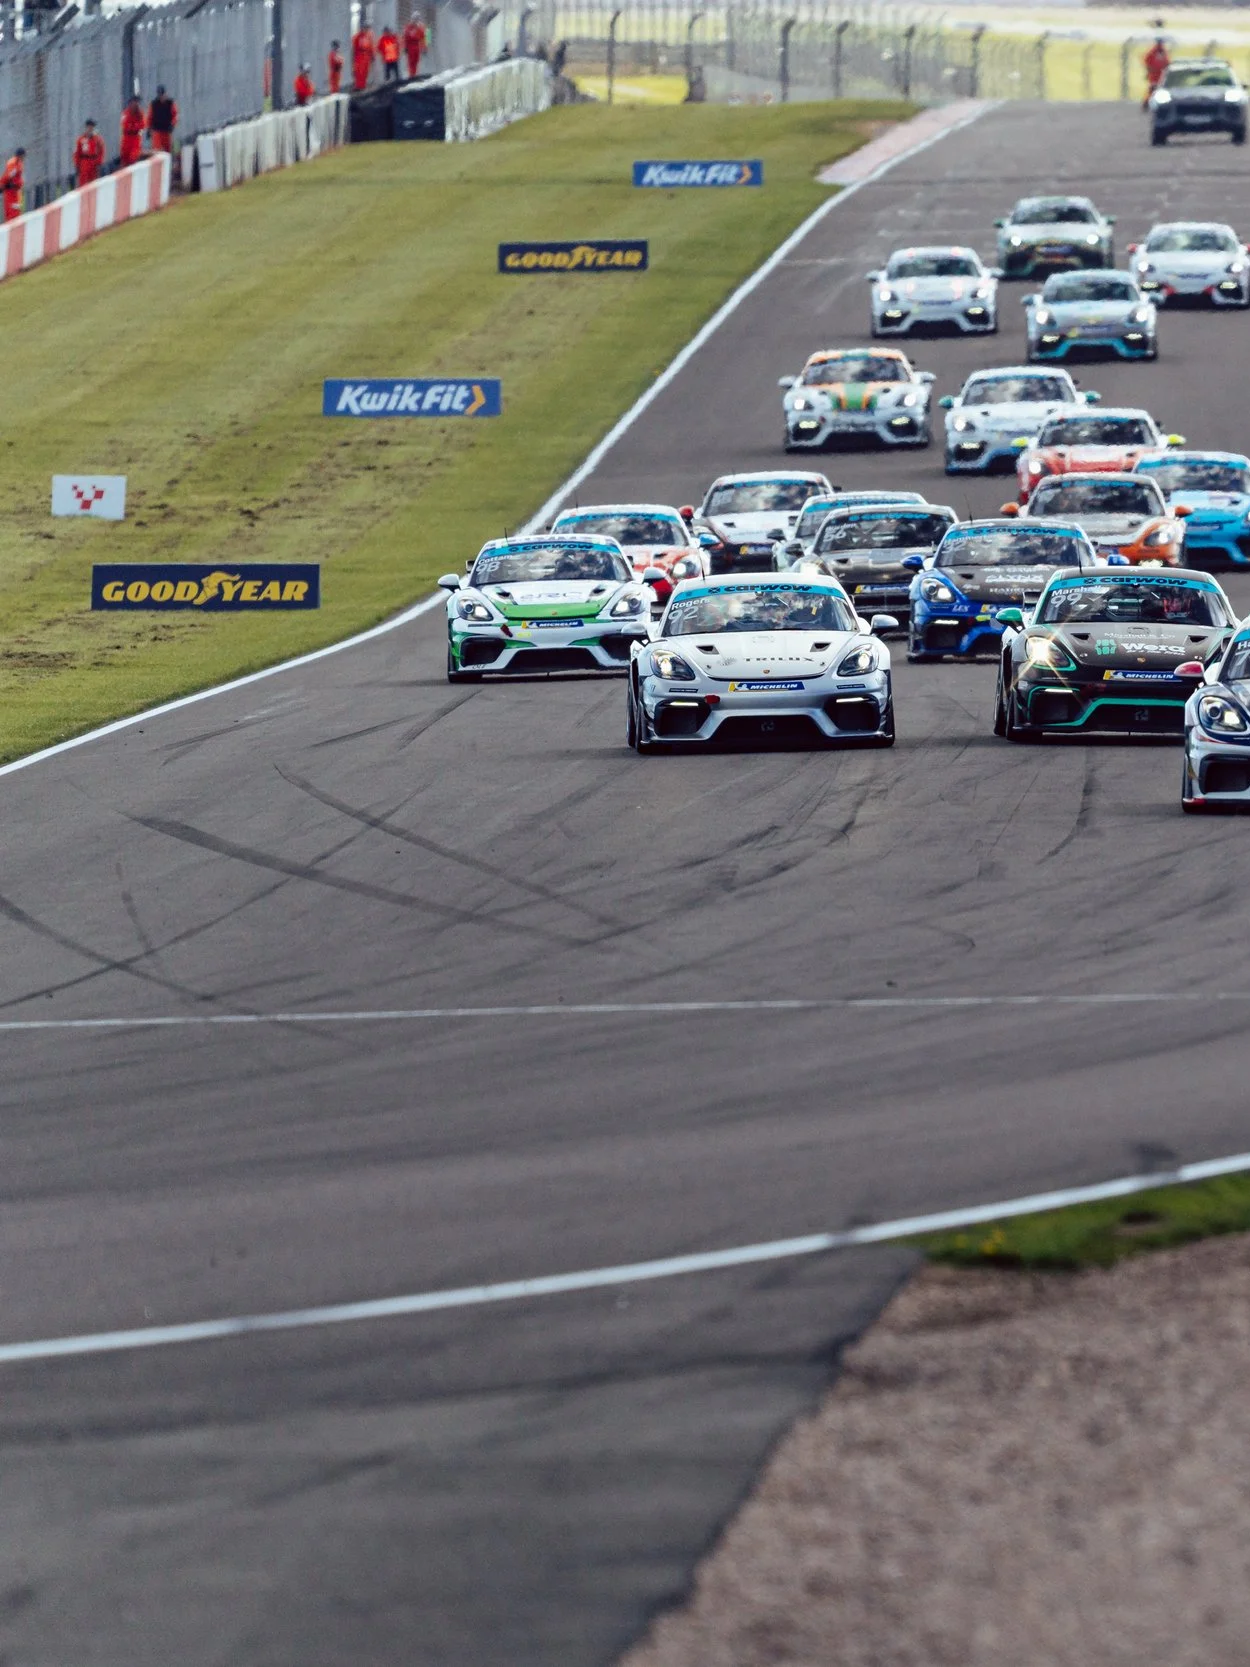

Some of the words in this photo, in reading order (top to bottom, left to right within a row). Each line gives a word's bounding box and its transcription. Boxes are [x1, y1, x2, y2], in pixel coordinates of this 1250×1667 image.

[522, 543, 594, 551] carwow
[478, 555, 513, 565] Cottam
[476, 561, 501, 574] 98
[1100, 577, 1188, 585] carwow
[102, 576, 309, 604] GOODYEAR
[724, 584, 812, 592] carwow
[1050, 592, 1082, 608] 99
[668, 606, 699, 624] 92
